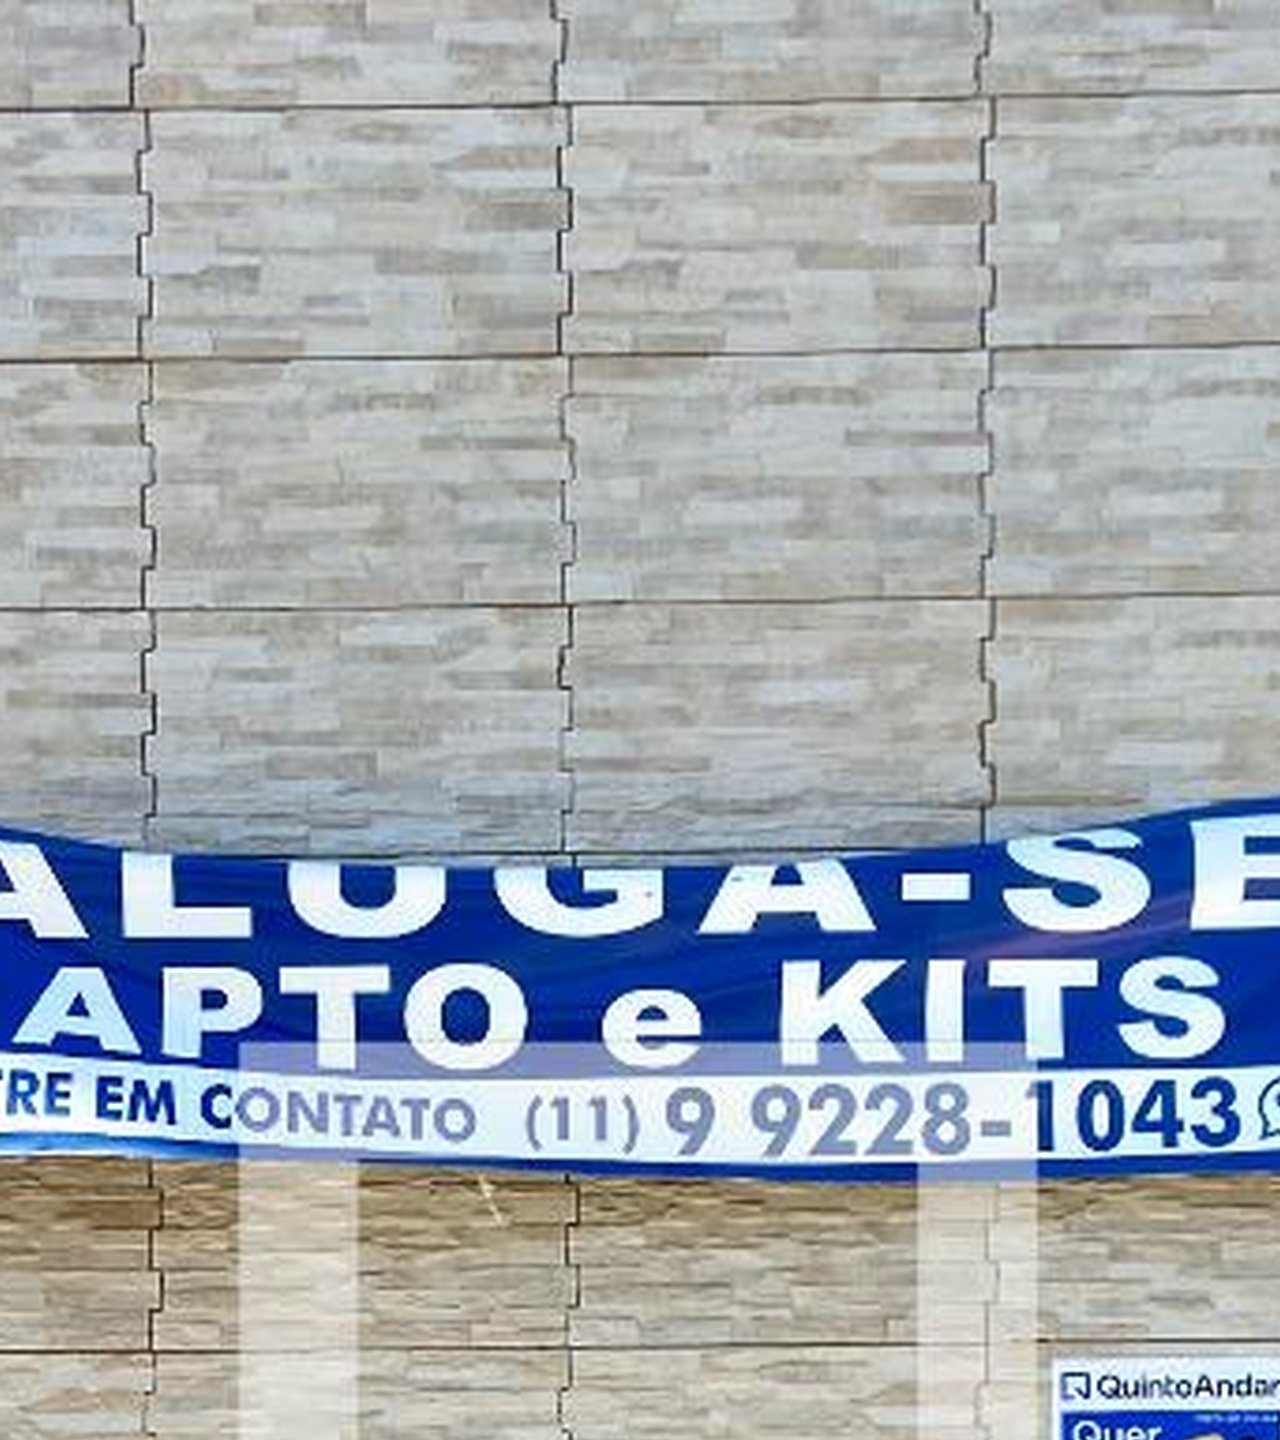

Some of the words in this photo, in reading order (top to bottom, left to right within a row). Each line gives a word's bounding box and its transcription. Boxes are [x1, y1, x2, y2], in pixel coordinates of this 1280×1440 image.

[12, 962, 528, 1073] APTO
[602, 988, 701, 1069] e
[780, 955, 1227, 1068] KITS
[96, 1074, 177, 1127] EM
[200, 1081, 477, 1144] CONTATO
[526, 1095, 640, 1154] (11)
[664, 1083, 717, 1157] 9
[749, 1075, 1241, 1158] 9228-1043
